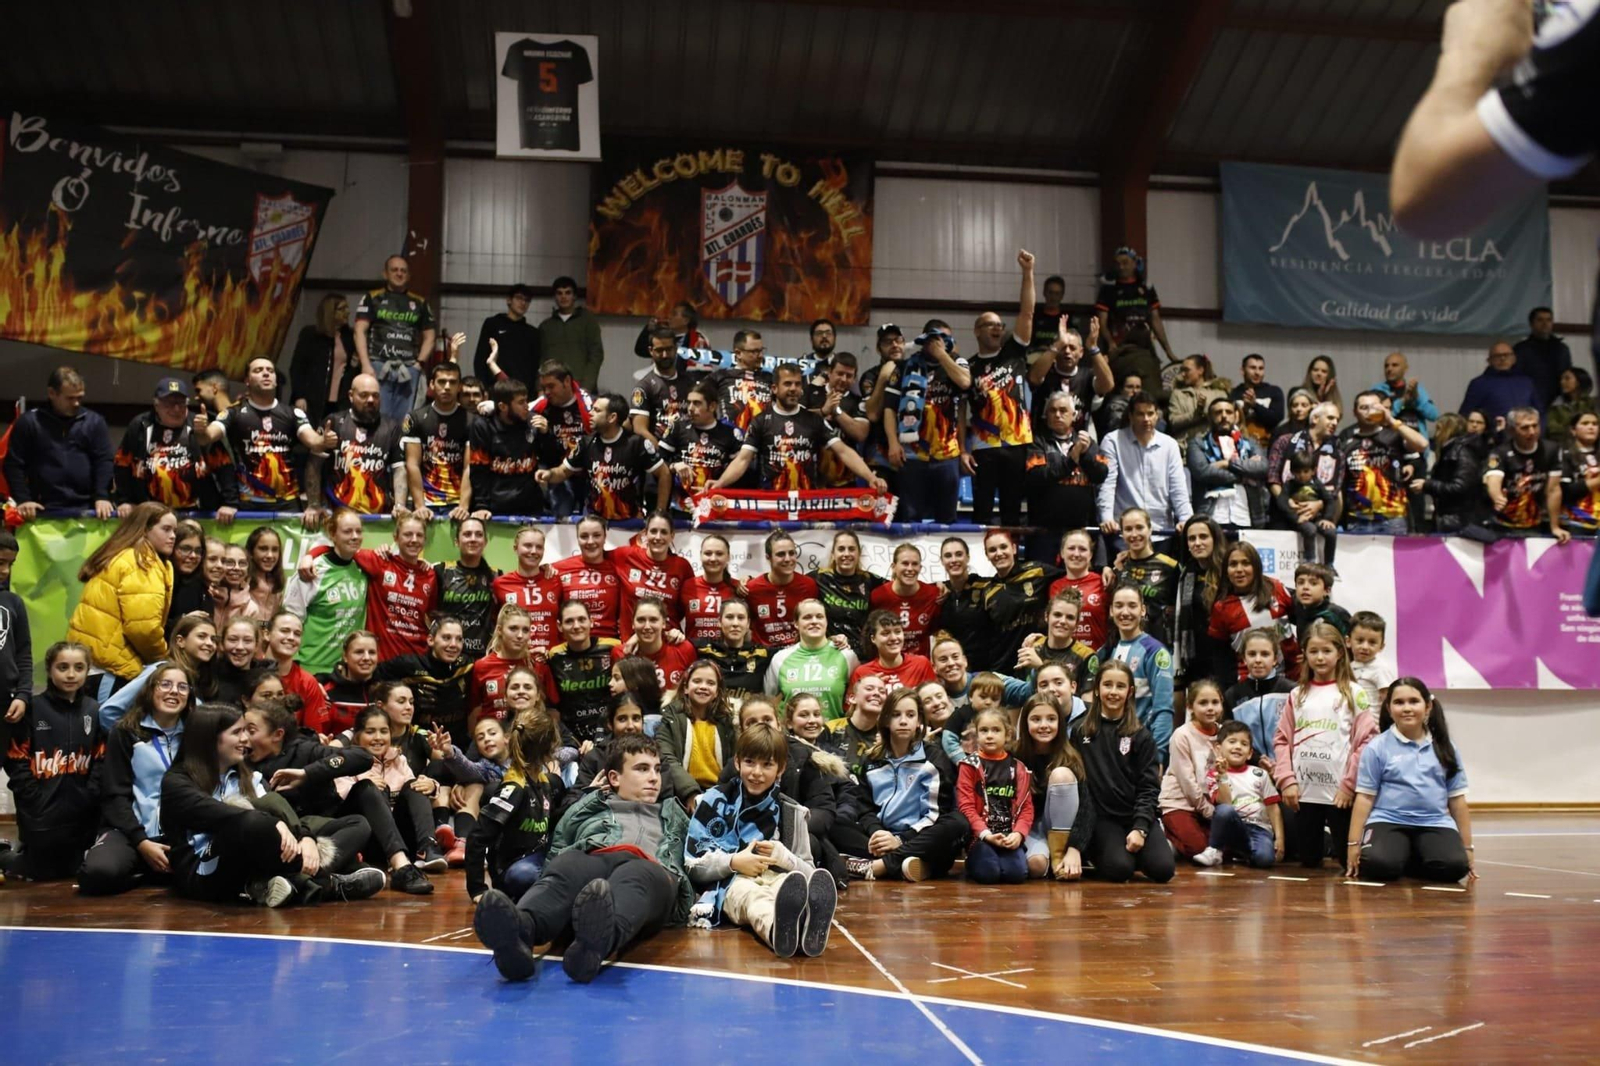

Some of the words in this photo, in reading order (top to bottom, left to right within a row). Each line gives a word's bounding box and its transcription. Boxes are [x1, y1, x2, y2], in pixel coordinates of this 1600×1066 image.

[538, 62, 558, 92] 5
[10, 111, 181, 192] Benvidos
[596, 148, 745, 220] WELCOME
[761, 153, 801, 187] TO
[807, 178, 865, 248] HELL
[125, 191, 244, 244] Inferno
[1321, 300, 1391, 321] Calidad
[1395, 304, 1416, 321] de
[1421, 305, 1460, 323] vida
[403, 573, 416, 593] 4
[579, 570, 602, 585] 20
[645, 569, 667, 588] 22
[523, 587, 544, 606] 15
[776, 598, 787, 618] 5
[803, 664, 823, 682] 12
